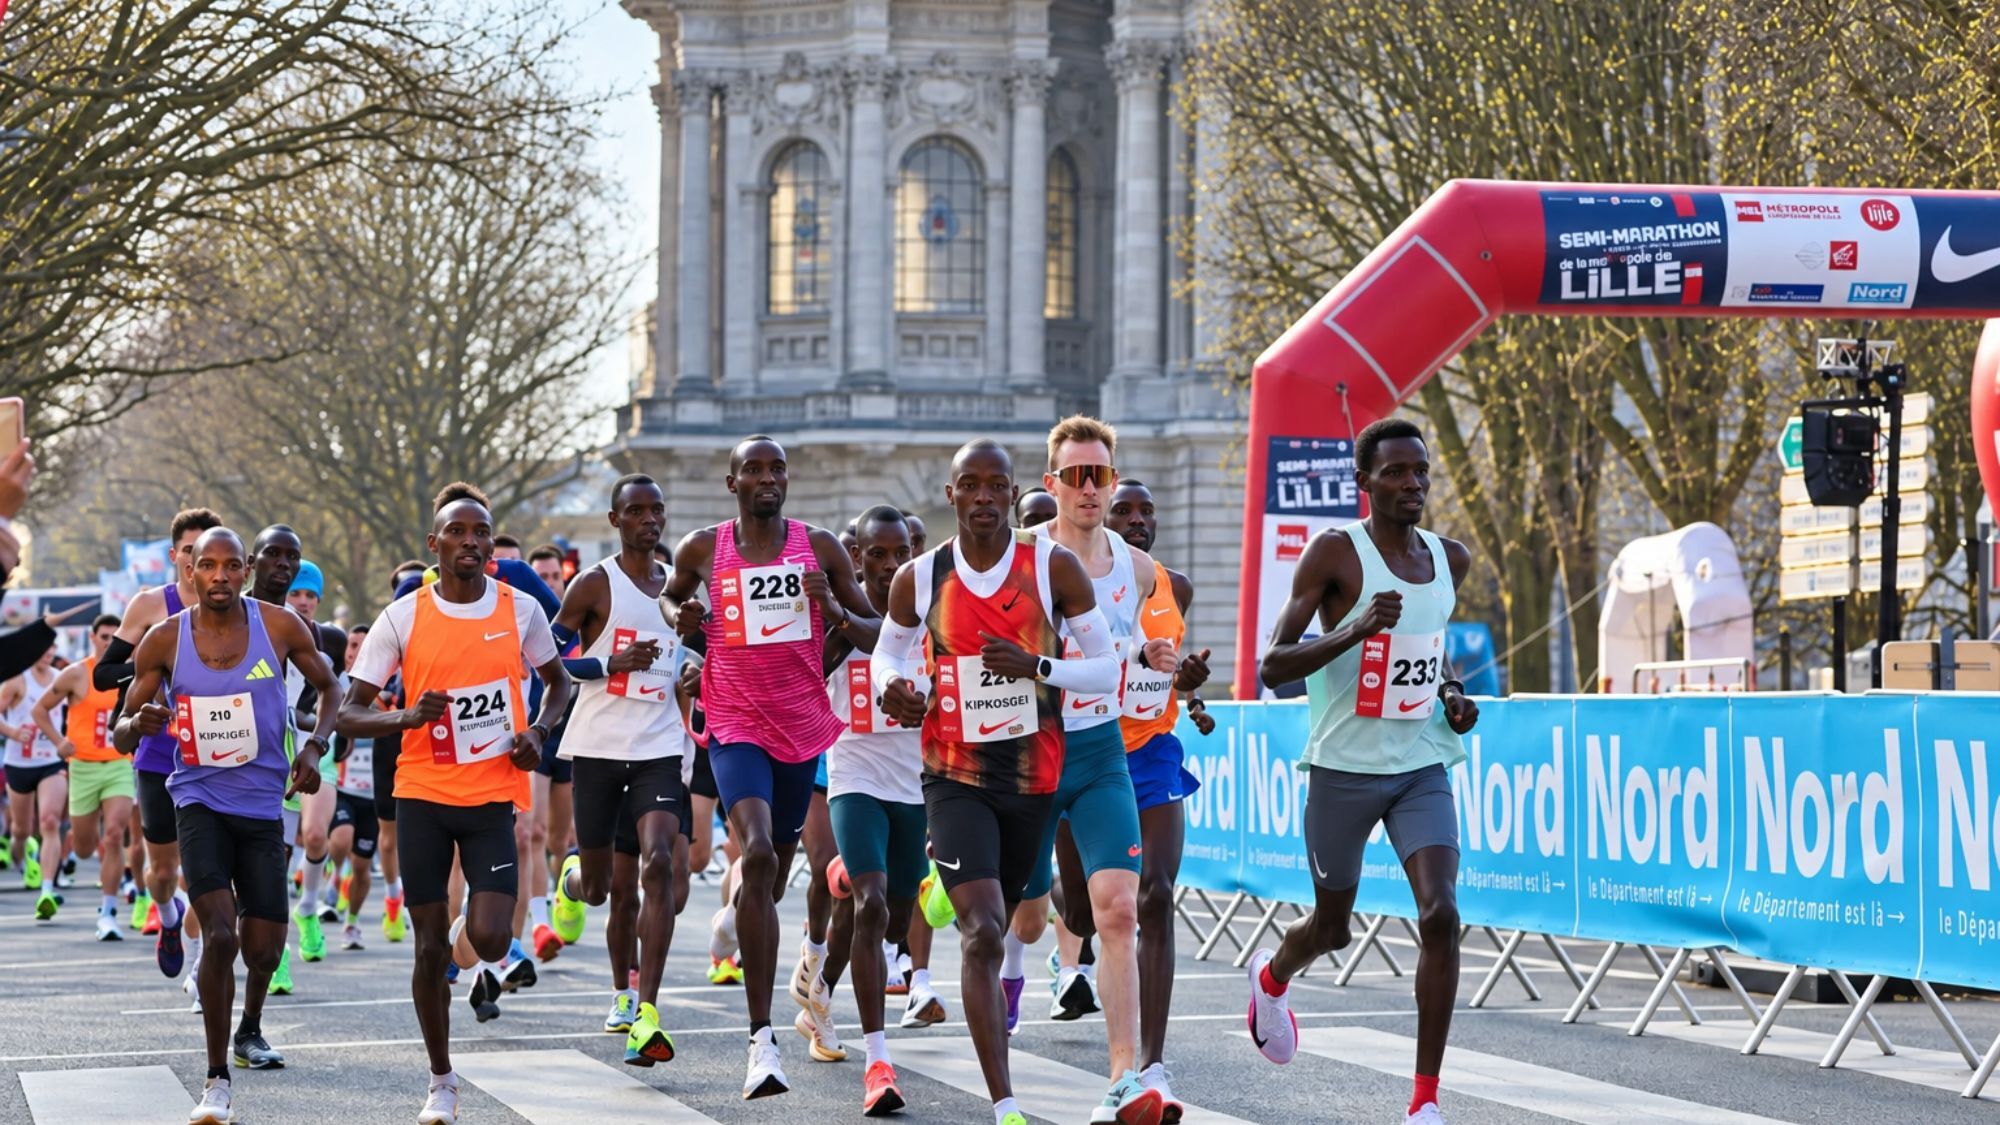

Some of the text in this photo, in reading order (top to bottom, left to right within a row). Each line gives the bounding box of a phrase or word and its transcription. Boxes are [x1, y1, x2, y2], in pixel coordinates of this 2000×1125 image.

[1767, 203, 1840, 213] MÉTROPOLE
[1559, 221, 1721, 249] SEMI-MARATHON
[1853, 285, 1903, 299] Nord
[749, 573, 801, 601] 228
[1391, 657, 1437, 687] 233
[210, 710, 231, 722] 210
[456, 689, 506, 721] 224
[965, 695, 1029, 710] KIPKOSGEI
[199, 729, 250, 741] KIPKIGEI
[1187, 727, 1235, 831] ord
[1451, 726, 1565, 857] Nord
[1586, 726, 1718, 870] Nord
[1744, 728, 1904, 884] Nord
[1934, 739, 2000, 891] N
[1467, 866, 1523, 892] Département
[1525, 871, 1540, 891] est
[1542, 870, 1551, 893] là
[1588, 875, 1597, 898] le
[1600, 877, 1664, 906] Département
[1667, 887, 1684, 907] est
[1738, 888, 1883, 927] le Département est là
[1939, 907, 1952, 934] le
